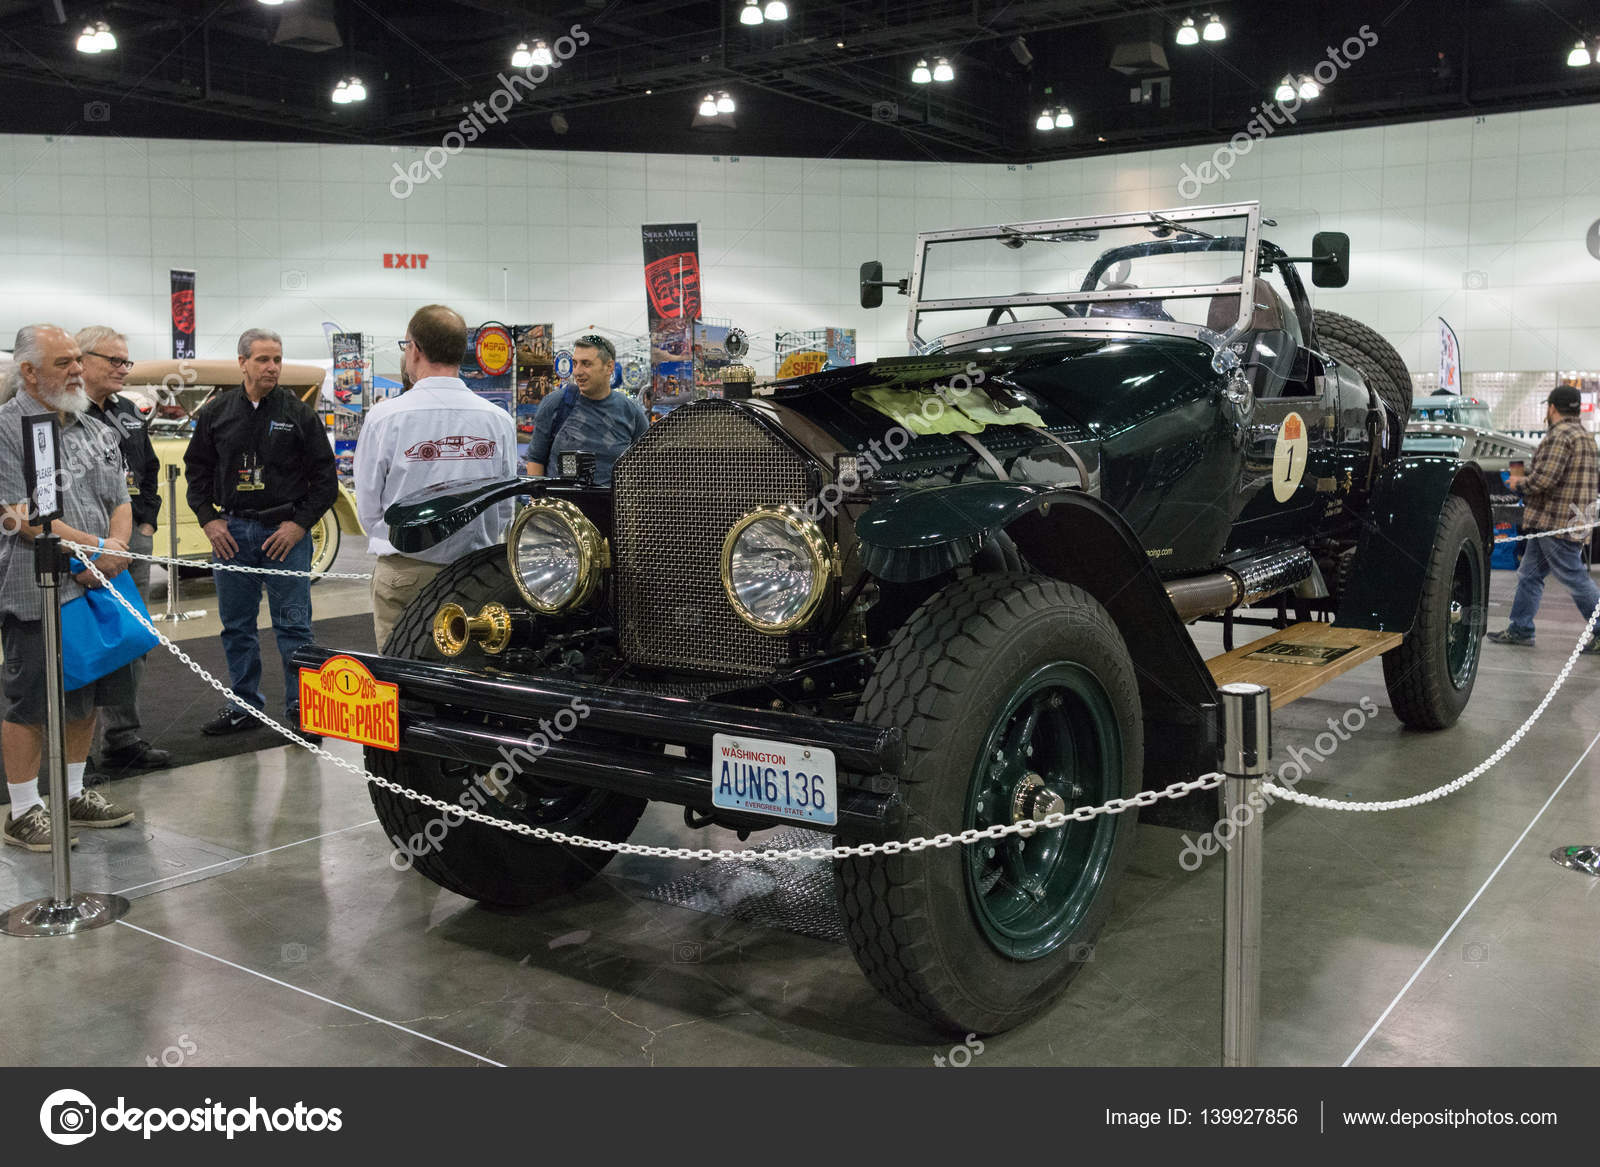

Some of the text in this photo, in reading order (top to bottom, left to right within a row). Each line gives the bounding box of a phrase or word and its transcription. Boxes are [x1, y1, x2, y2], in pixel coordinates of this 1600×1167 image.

[383, 253, 429, 269] EXIT
[1283, 445, 1294, 482] 1
[344, 674, 350, 690] 1
[303, 682, 349, 734] PEKING
[355, 699, 396, 744] PARIS
[721, 747, 786, 766] WASHINGTON
[719, 760, 825, 810] AUN6136
[745, 801, 804, 816] EVERGREEN STATE
